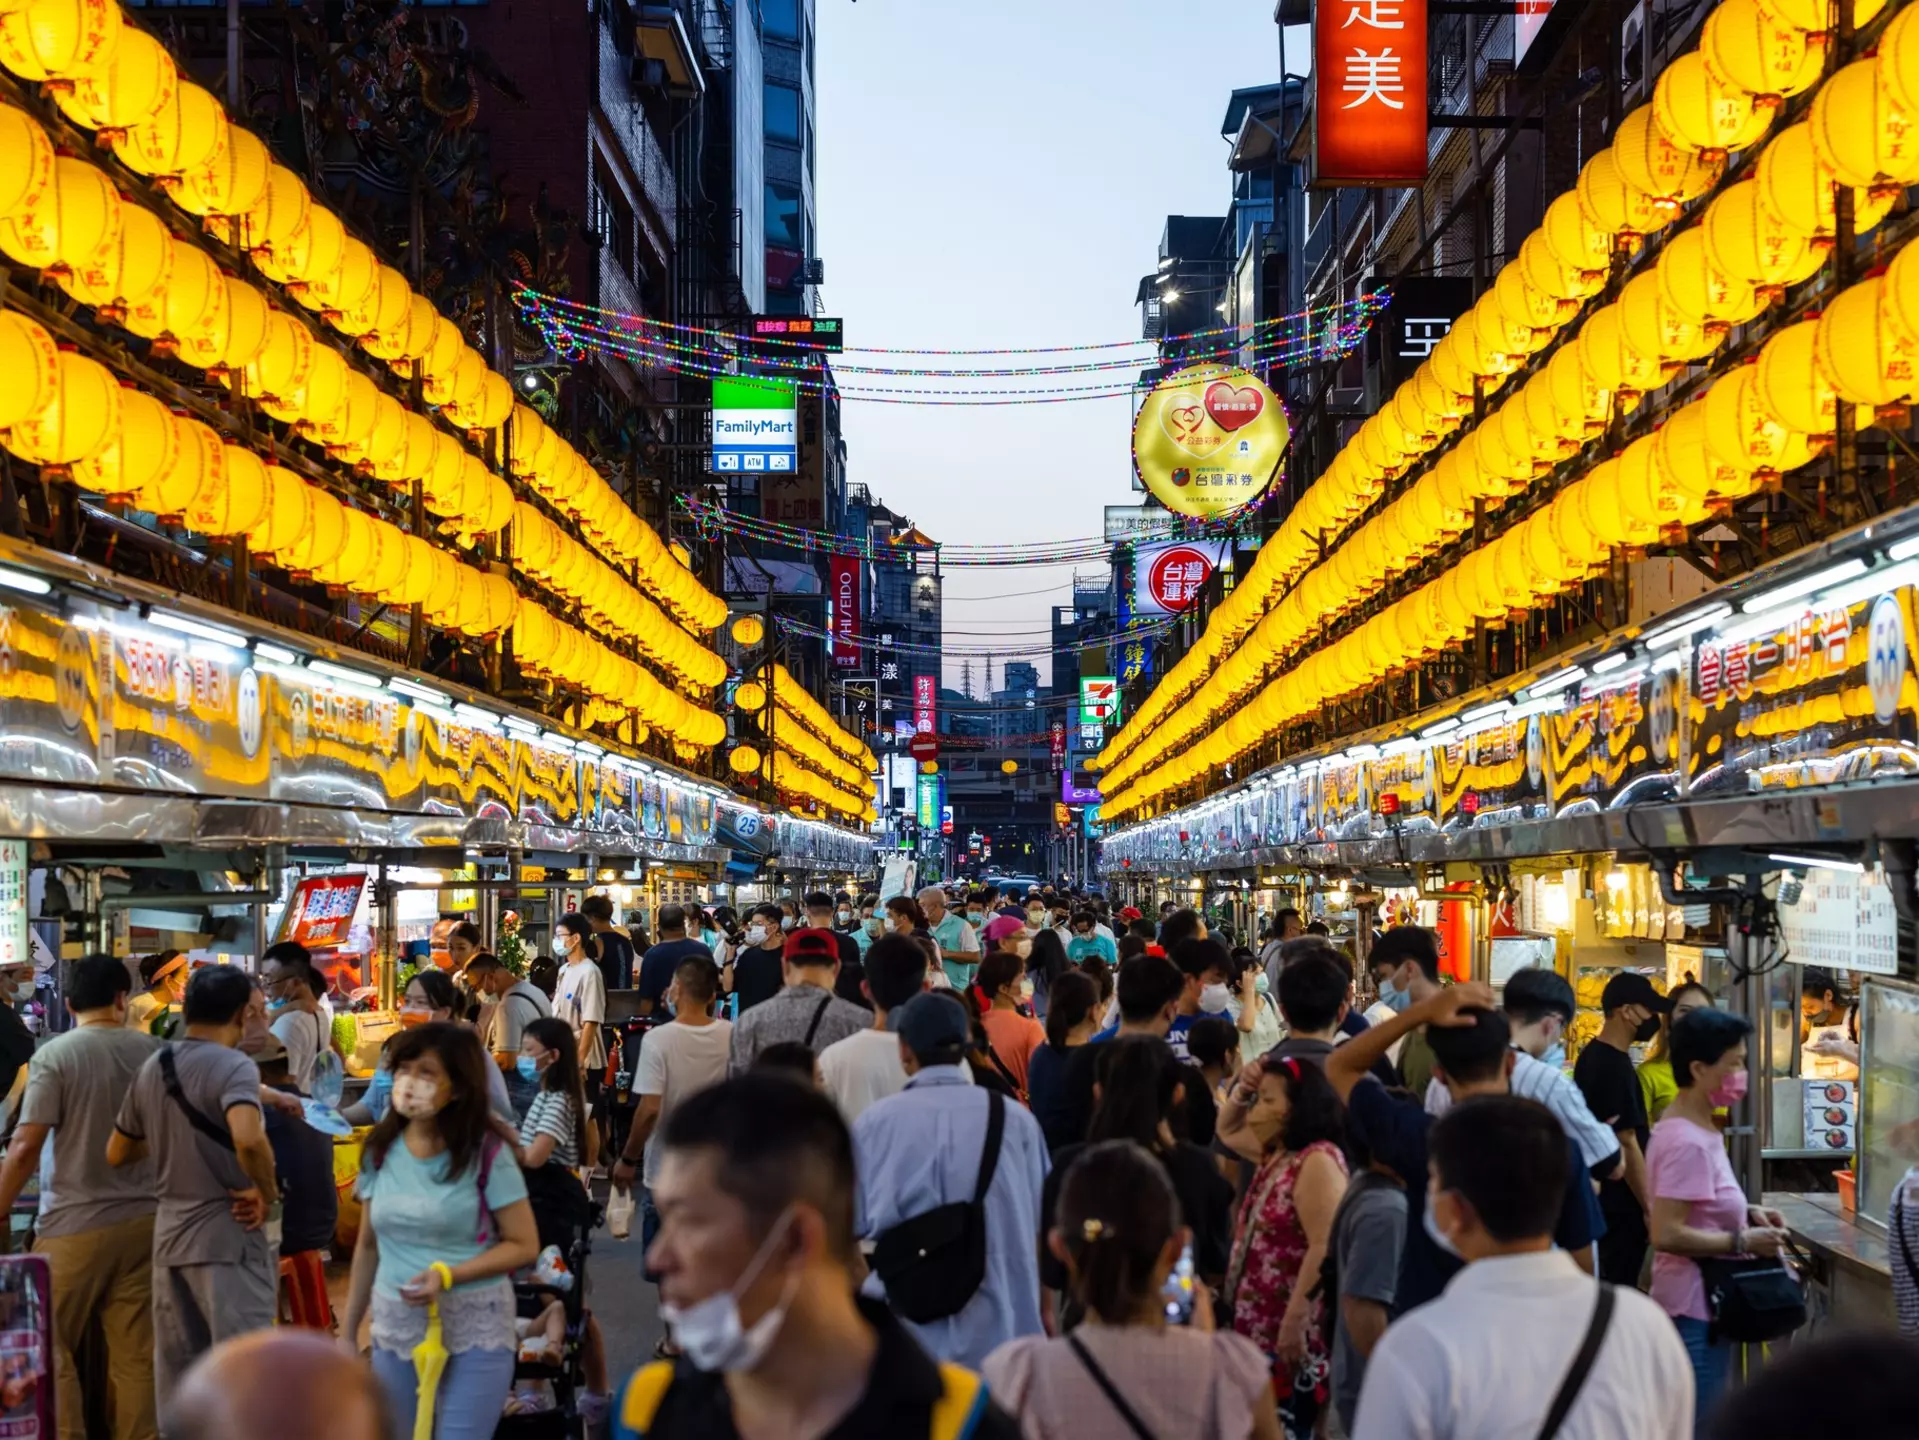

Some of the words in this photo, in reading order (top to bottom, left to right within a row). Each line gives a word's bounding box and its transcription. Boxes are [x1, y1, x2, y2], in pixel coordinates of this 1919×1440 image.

[716, 420, 793, 435] FamilyMart
[747, 457, 762, 466] ATM
[1195, 473, 1253, 486] 台灣彩券
[1163, 561, 1204, 581] 台灣
[1161, 581, 1203, 602] 運彩
[840, 572, 852, 648] SHISEIDO
[1699, 606, 1852, 708] 營養三明治
[738, 816, 757, 835] 25
